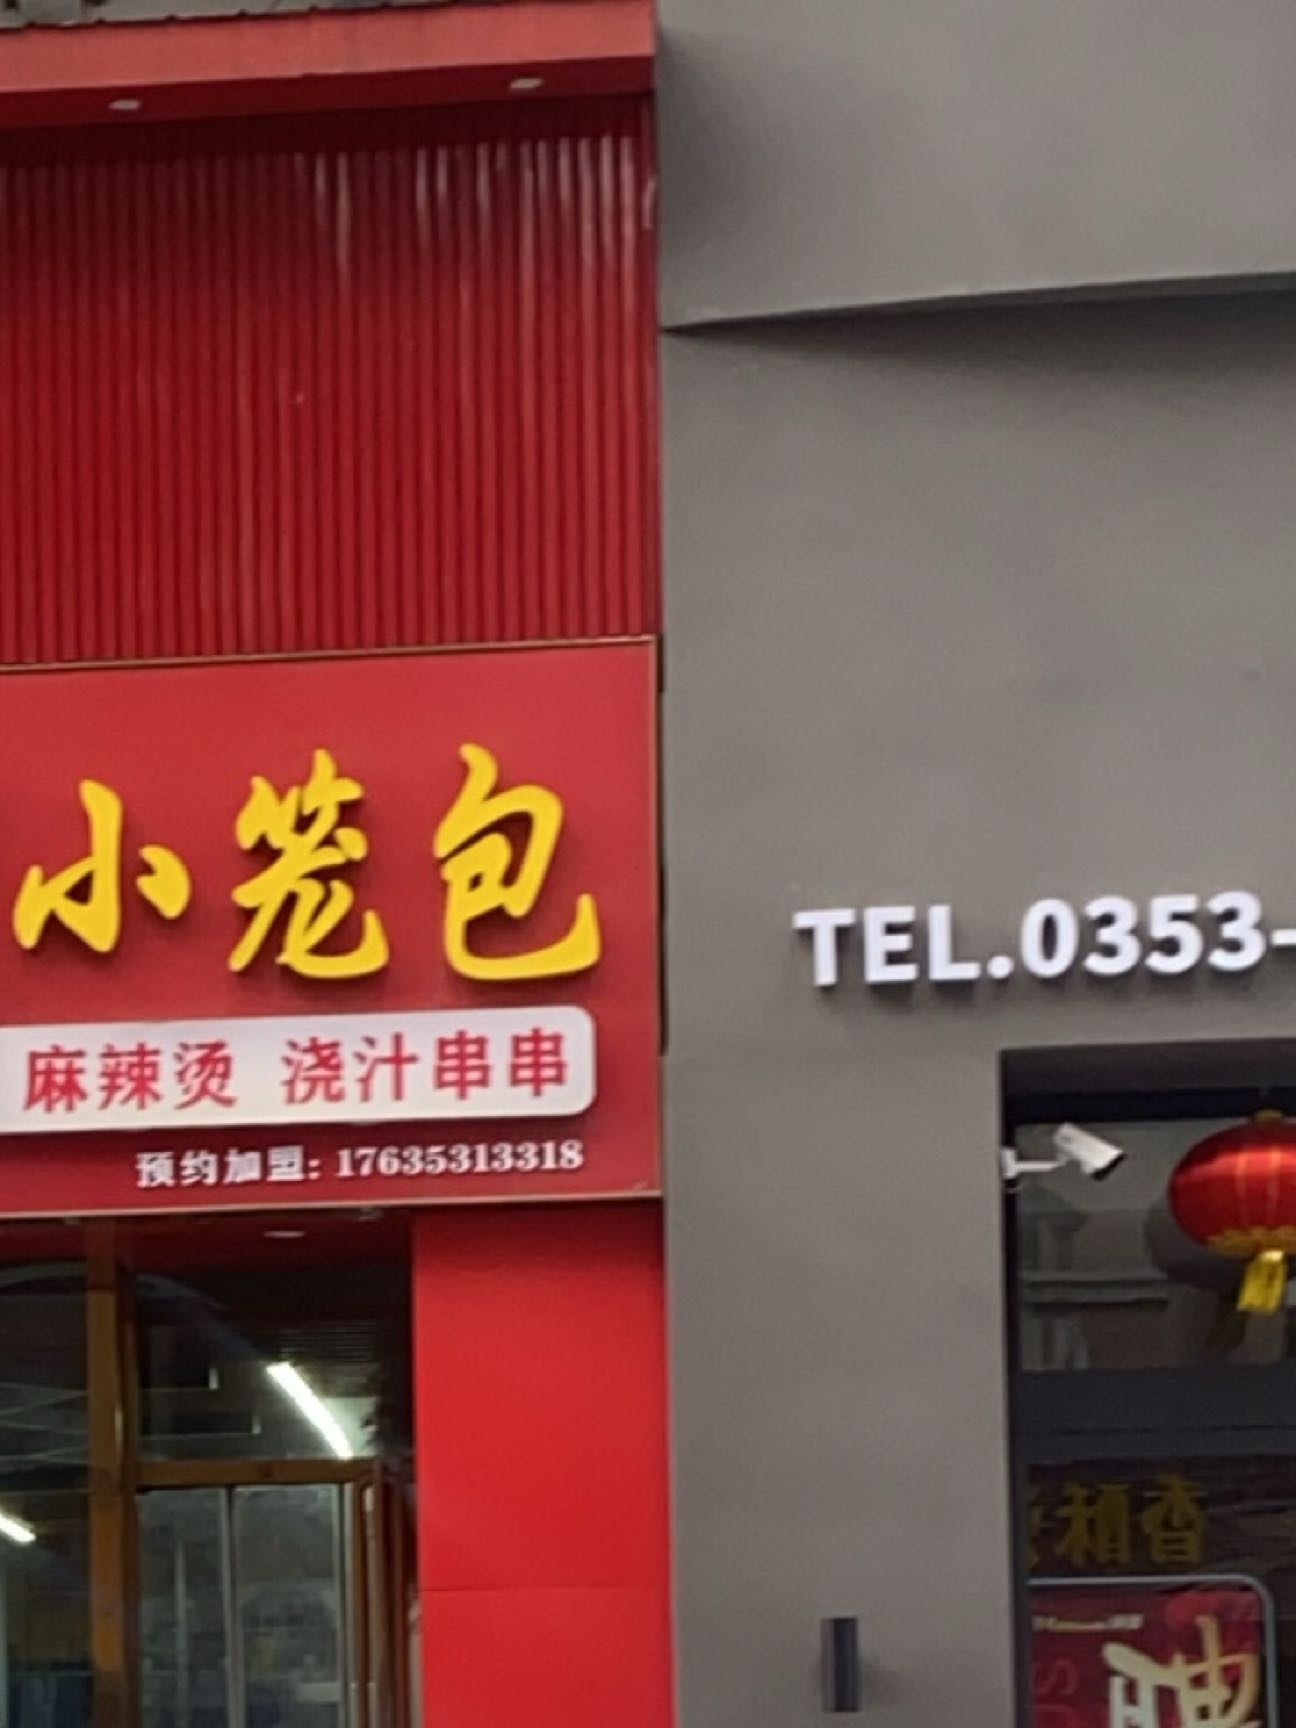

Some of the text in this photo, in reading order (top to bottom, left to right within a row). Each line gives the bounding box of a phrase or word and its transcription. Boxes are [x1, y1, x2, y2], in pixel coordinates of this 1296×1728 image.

[793, 891, 1296, 987] TEL.0353-
[23, 1039, 238, 1113] 麻辣烫
[281, 1027, 568, 1106] 浇汁串串
